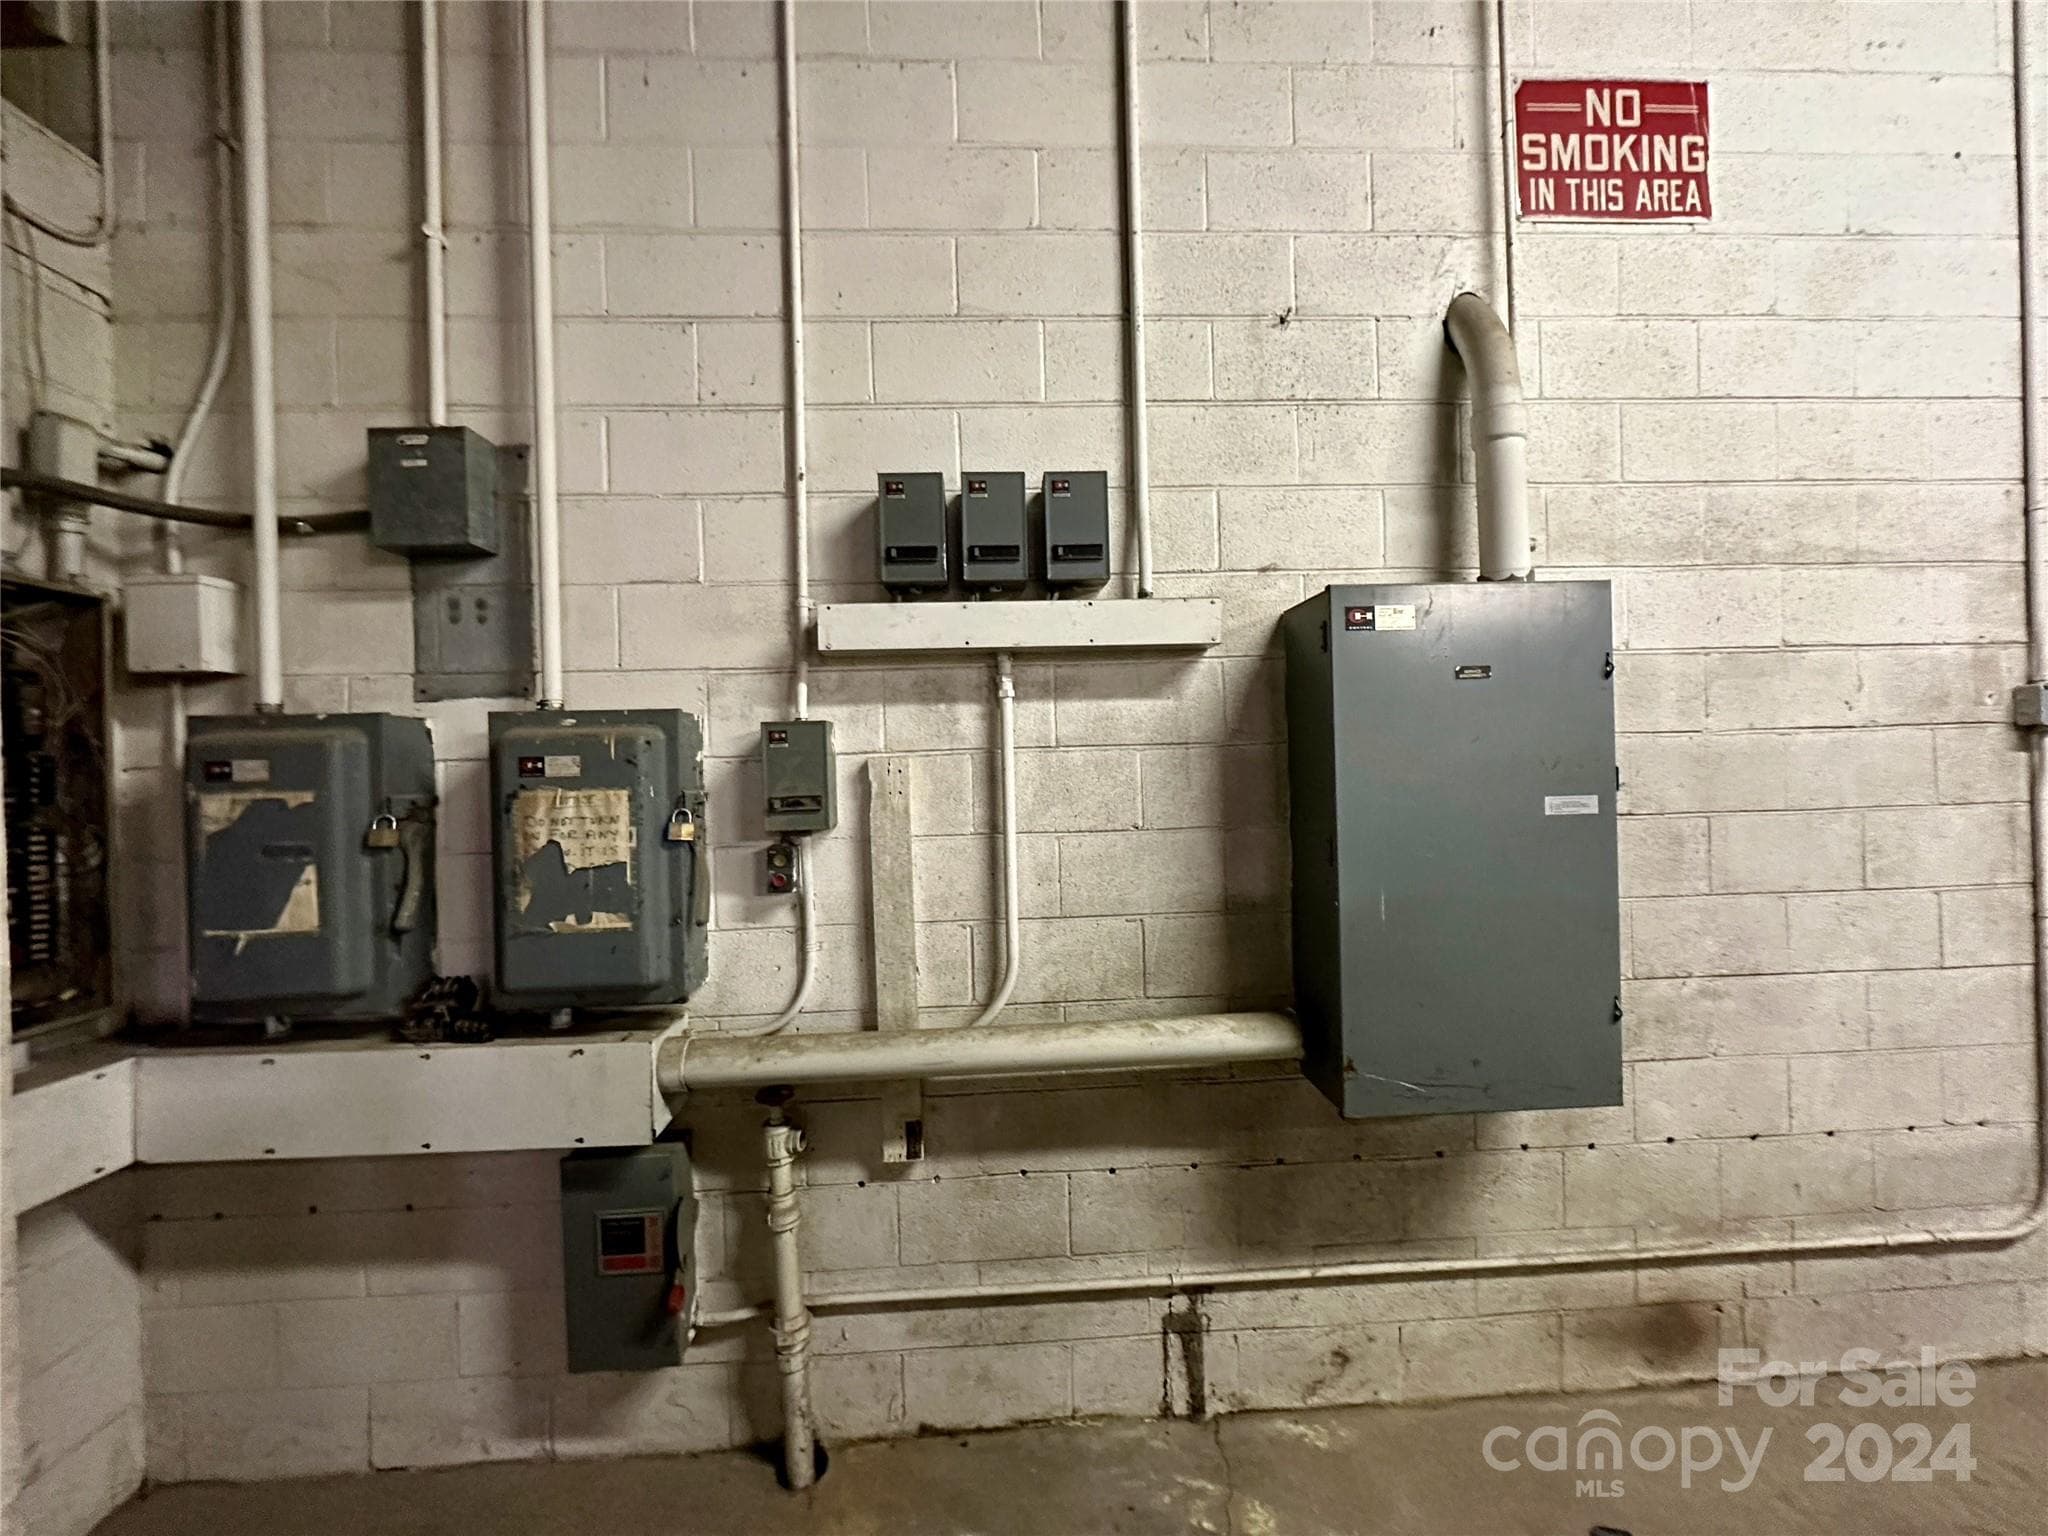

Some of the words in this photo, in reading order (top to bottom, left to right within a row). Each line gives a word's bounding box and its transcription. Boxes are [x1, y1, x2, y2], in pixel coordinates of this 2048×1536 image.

[1585, 88, 1641, 127] NO
[1521, 133, 1706, 172] SMOKING
[1529, 178, 1555, 211] IN
[1565, 178, 1625, 211] THIS
[1635, 179, 1703, 212] AREA
